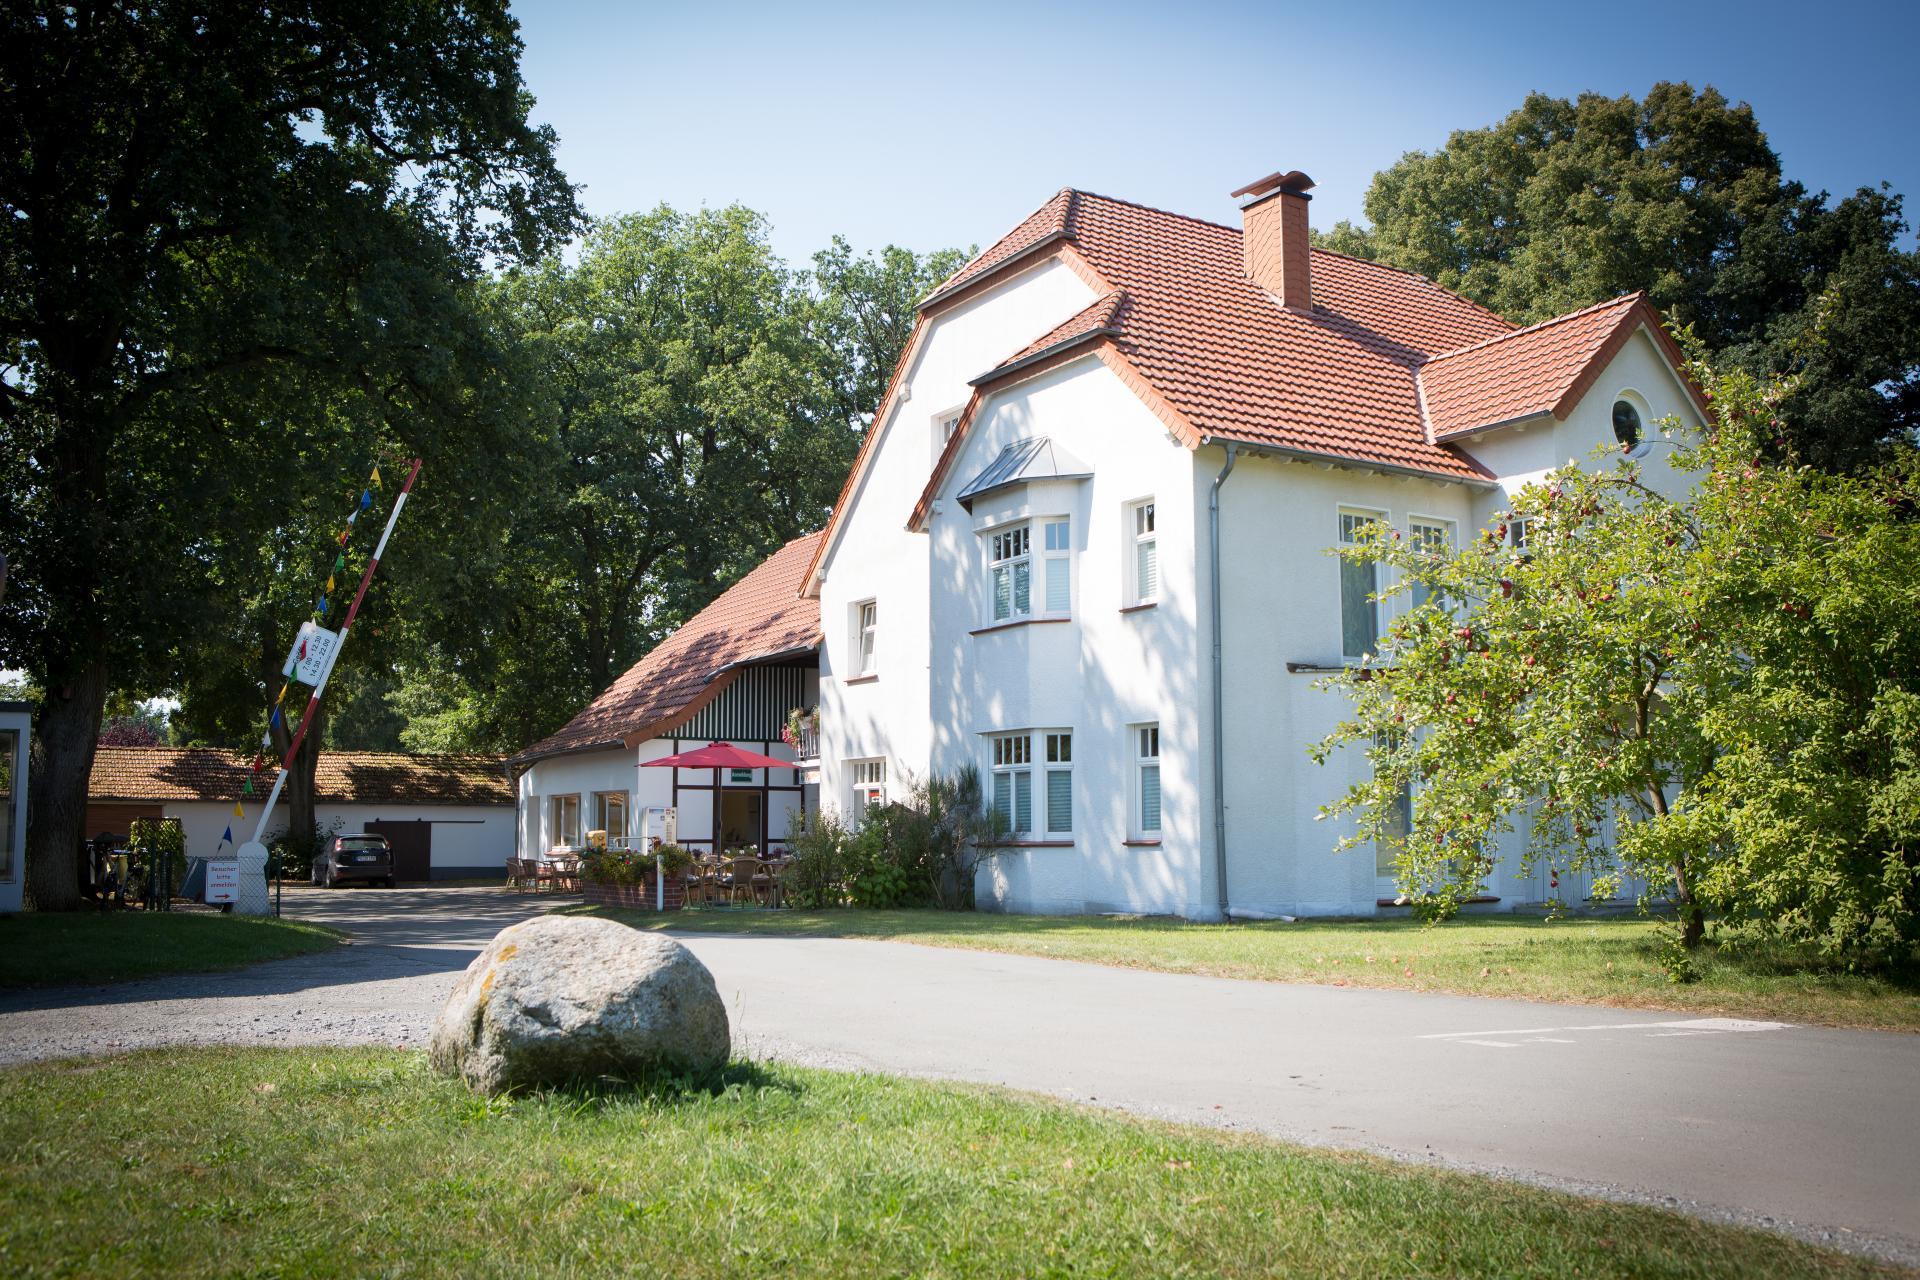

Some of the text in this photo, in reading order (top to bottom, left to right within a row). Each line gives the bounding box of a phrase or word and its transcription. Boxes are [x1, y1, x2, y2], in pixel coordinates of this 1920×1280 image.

[303, 657, 313, 671] 7.00
[312, 636, 321, 652] 12.30
[310, 660, 320, 676] 14.30
[319, 639, 330, 656] 22.00
